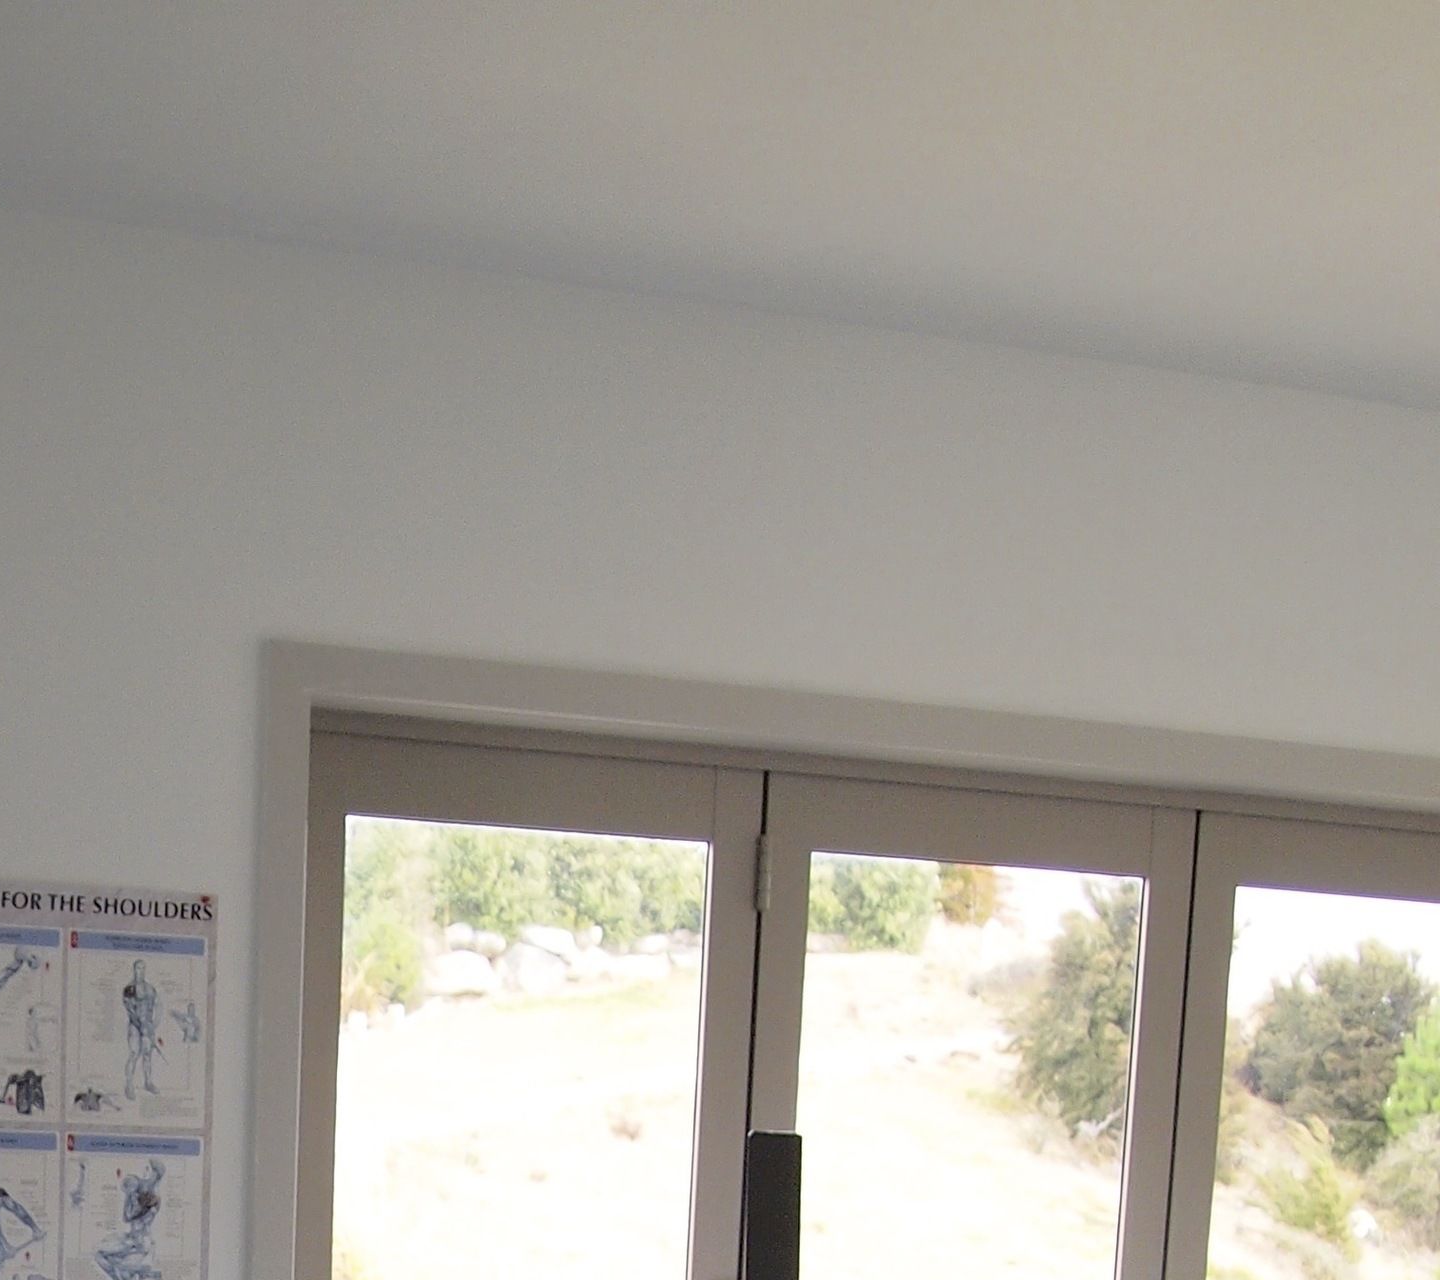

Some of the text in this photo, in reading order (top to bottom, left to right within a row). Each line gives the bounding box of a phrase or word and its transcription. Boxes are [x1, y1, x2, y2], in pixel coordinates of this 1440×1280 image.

[1, 890, 44, 911] FOR
[48, 894, 86, 914] THE
[93, 895, 214, 921] SHOULDERS
